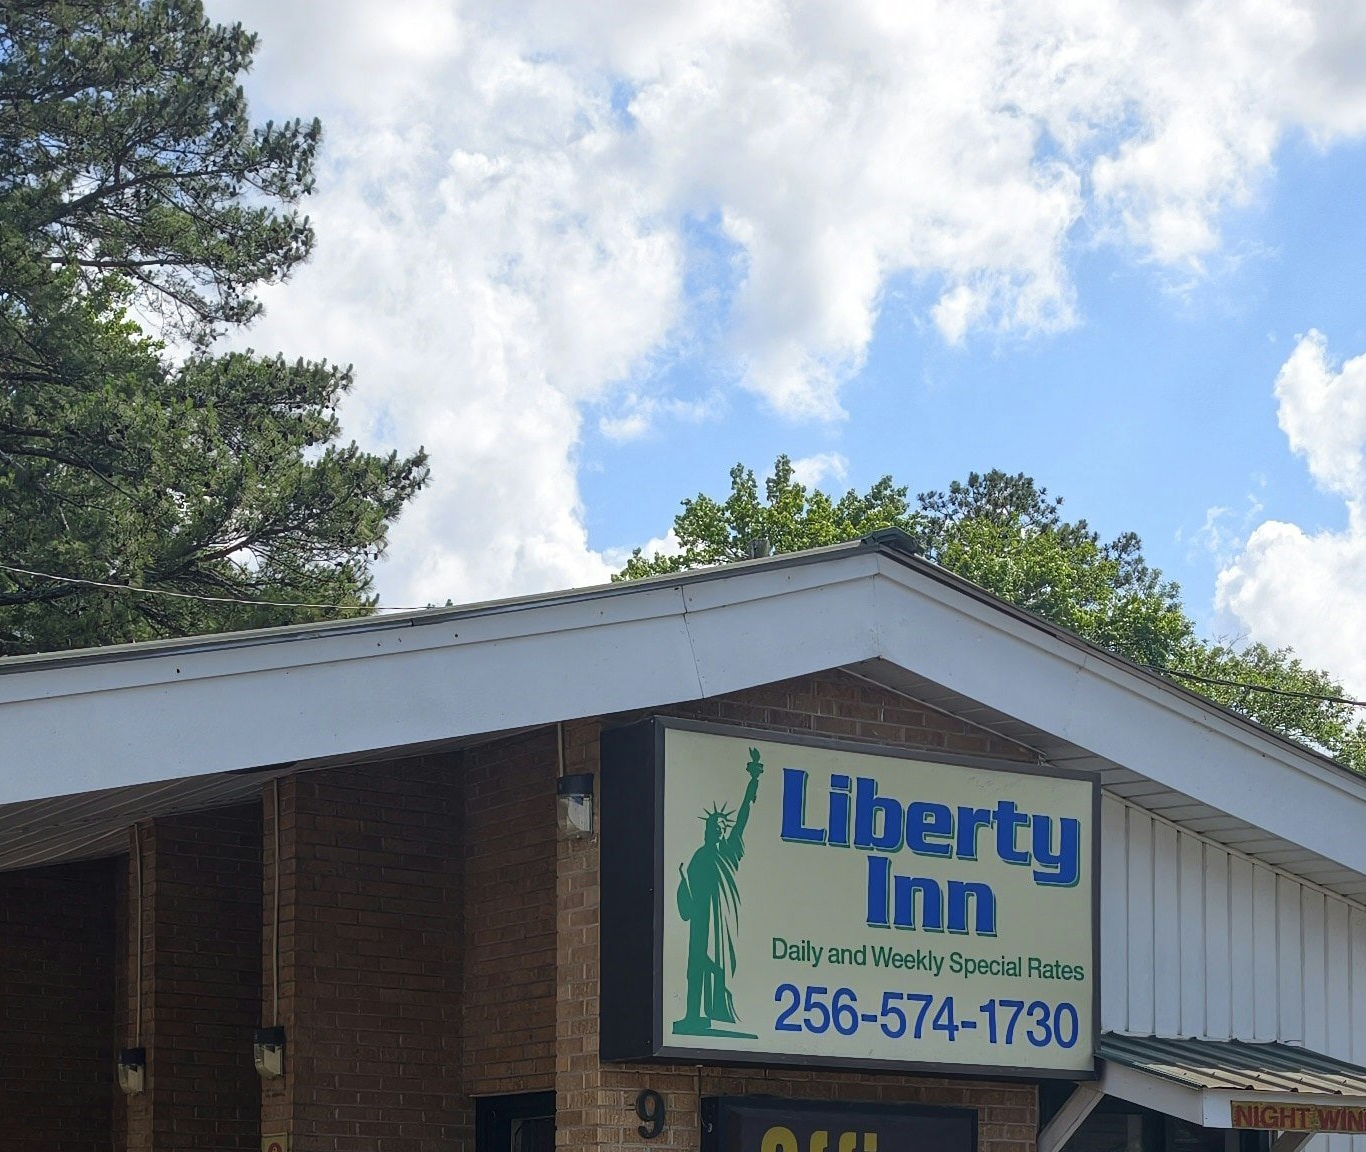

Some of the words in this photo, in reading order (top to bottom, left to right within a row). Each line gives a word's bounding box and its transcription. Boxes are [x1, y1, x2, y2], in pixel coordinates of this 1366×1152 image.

[780, 768, 1081, 888] Liberty
[865, 856, 998, 938] Inn
[771, 938, 823, 968] Daily
[828, 944, 867, 967] and
[871, 945, 944, 977] Weekly
[949, 951, 1022, 979] Special
[1027, 957, 1085, 981] Rates
[774, 983, 1079, 1049] 256-574-1730
[1235, 1104, 1311, 1129] NIGHT
